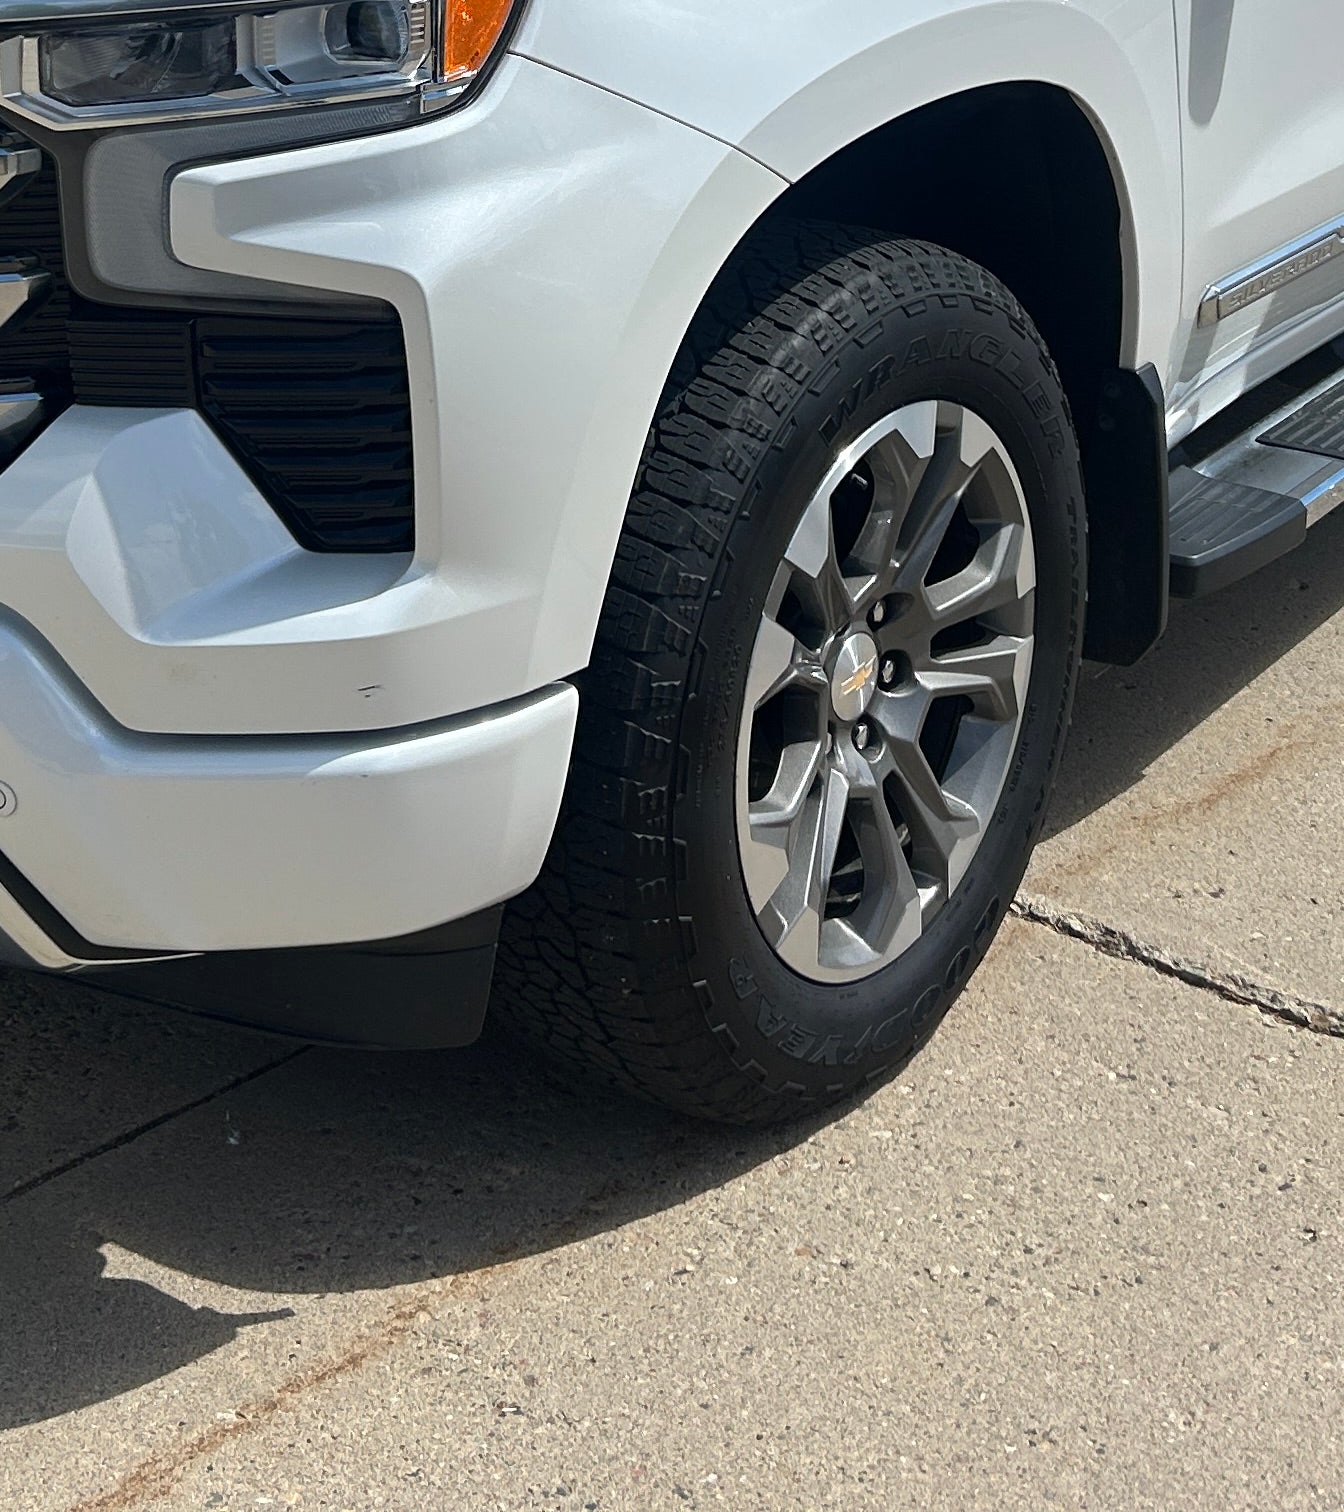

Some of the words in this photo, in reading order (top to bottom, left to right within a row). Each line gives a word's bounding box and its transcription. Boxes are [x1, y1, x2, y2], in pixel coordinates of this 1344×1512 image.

[1229, 242, 1335, 309] SILVERADO
[818, 328, 1065, 459] WRANGLER
[728, 893, 1000, 1067] GOODYEAR
